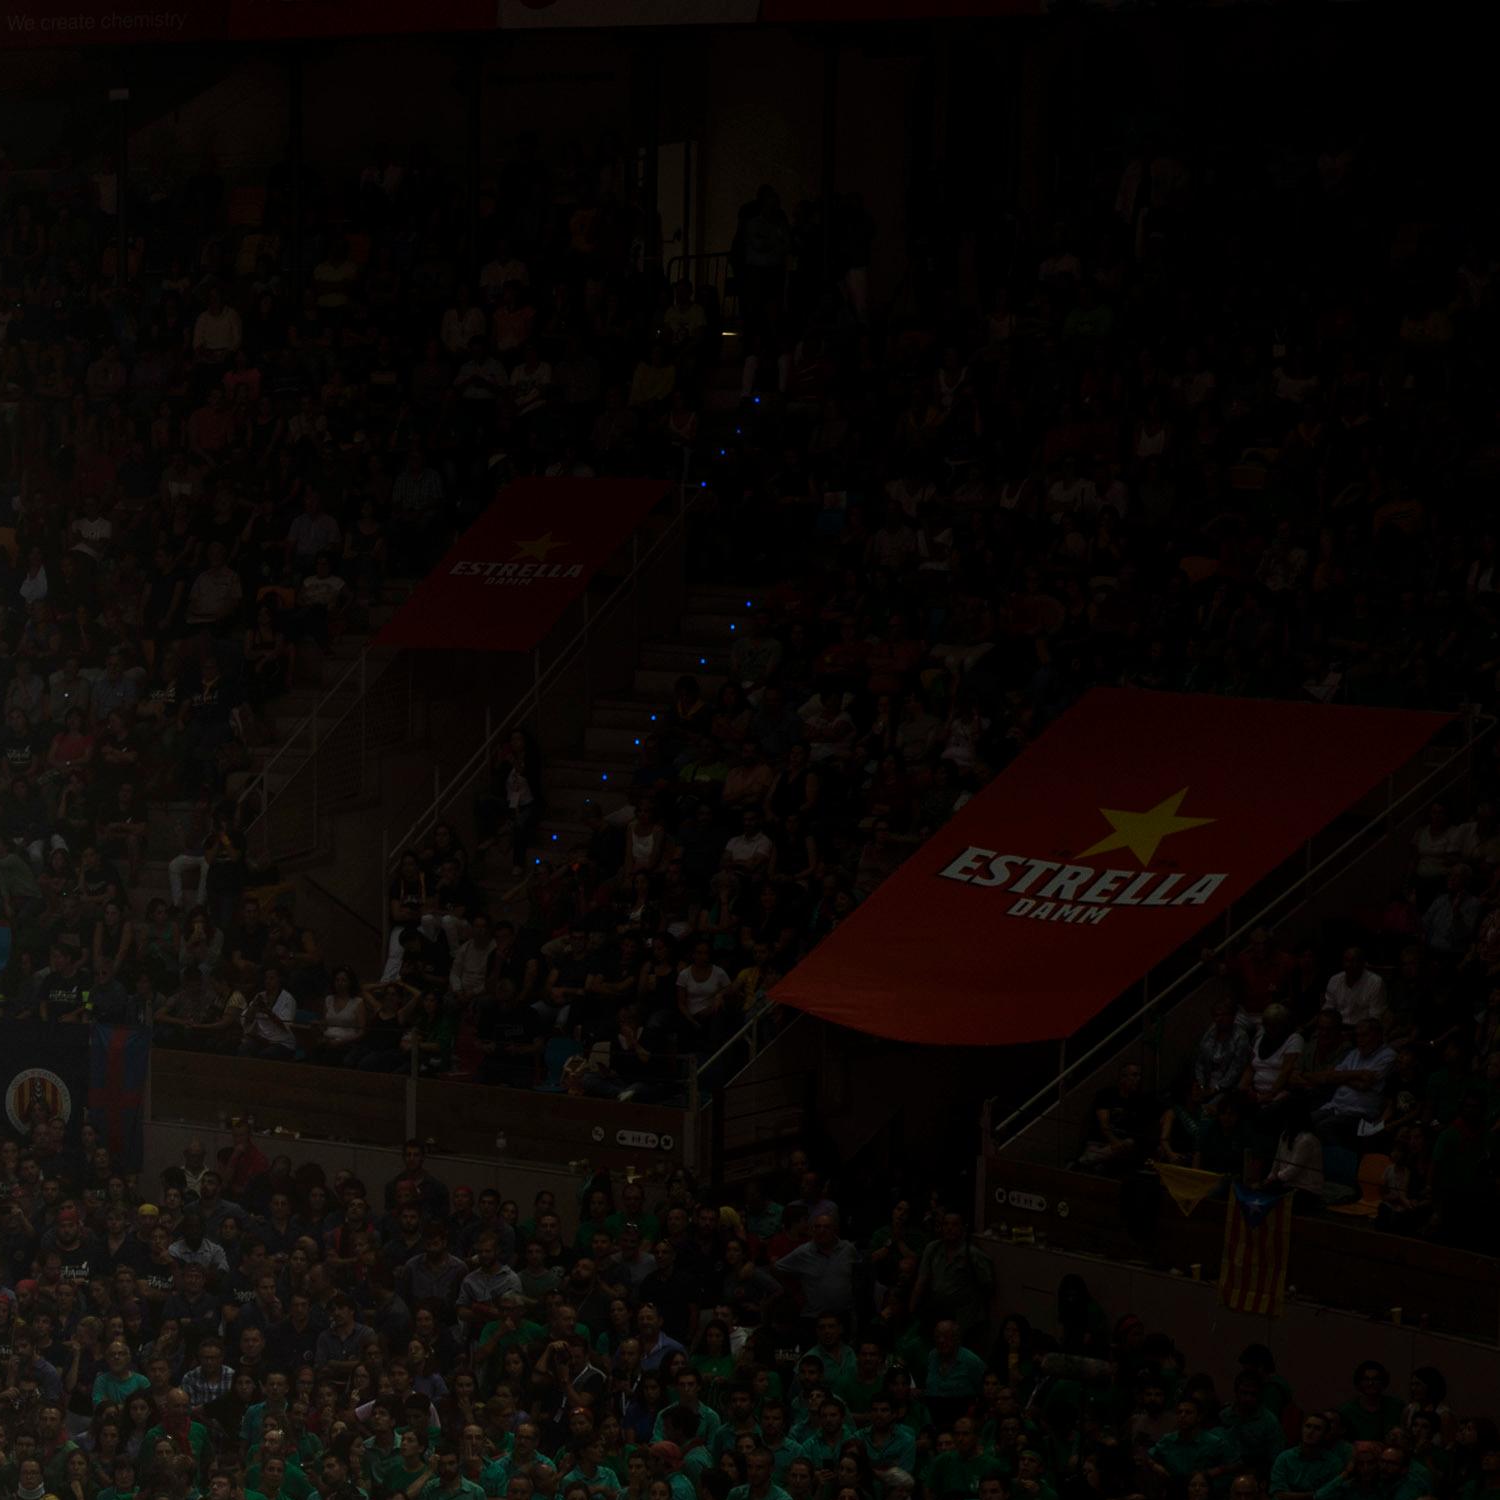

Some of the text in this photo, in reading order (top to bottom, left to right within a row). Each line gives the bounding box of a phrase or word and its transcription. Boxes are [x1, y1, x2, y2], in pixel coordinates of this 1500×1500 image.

[7, 11, 189, 31] We create chemistry
[449, 560, 584, 578] ESTRELLA
[483, 577, 533, 586] DAMM
[938, 845, 1229, 906] ESTRELLA
[1006, 898, 1113, 924] DAMM
